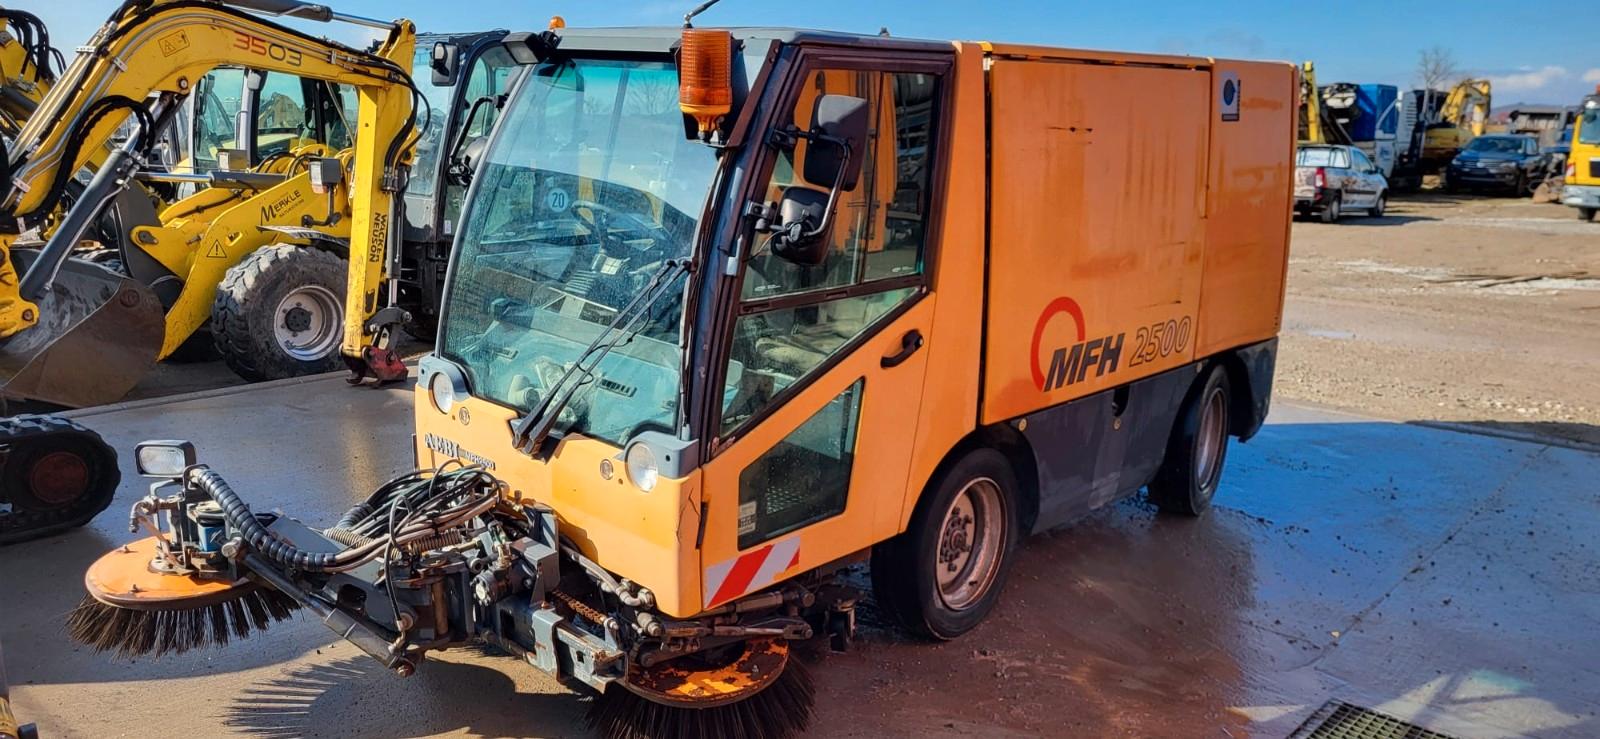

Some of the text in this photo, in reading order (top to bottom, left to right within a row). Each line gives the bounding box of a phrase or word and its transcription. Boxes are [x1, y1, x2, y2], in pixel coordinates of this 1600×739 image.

[233, 31, 302, 67] 3503
[552, 192, 565, 208] 20
[369, 212, 381, 263] NEUSON
[376, 214, 387, 263] WACKER
[1044, 315, 1192, 392] MFH 2500
